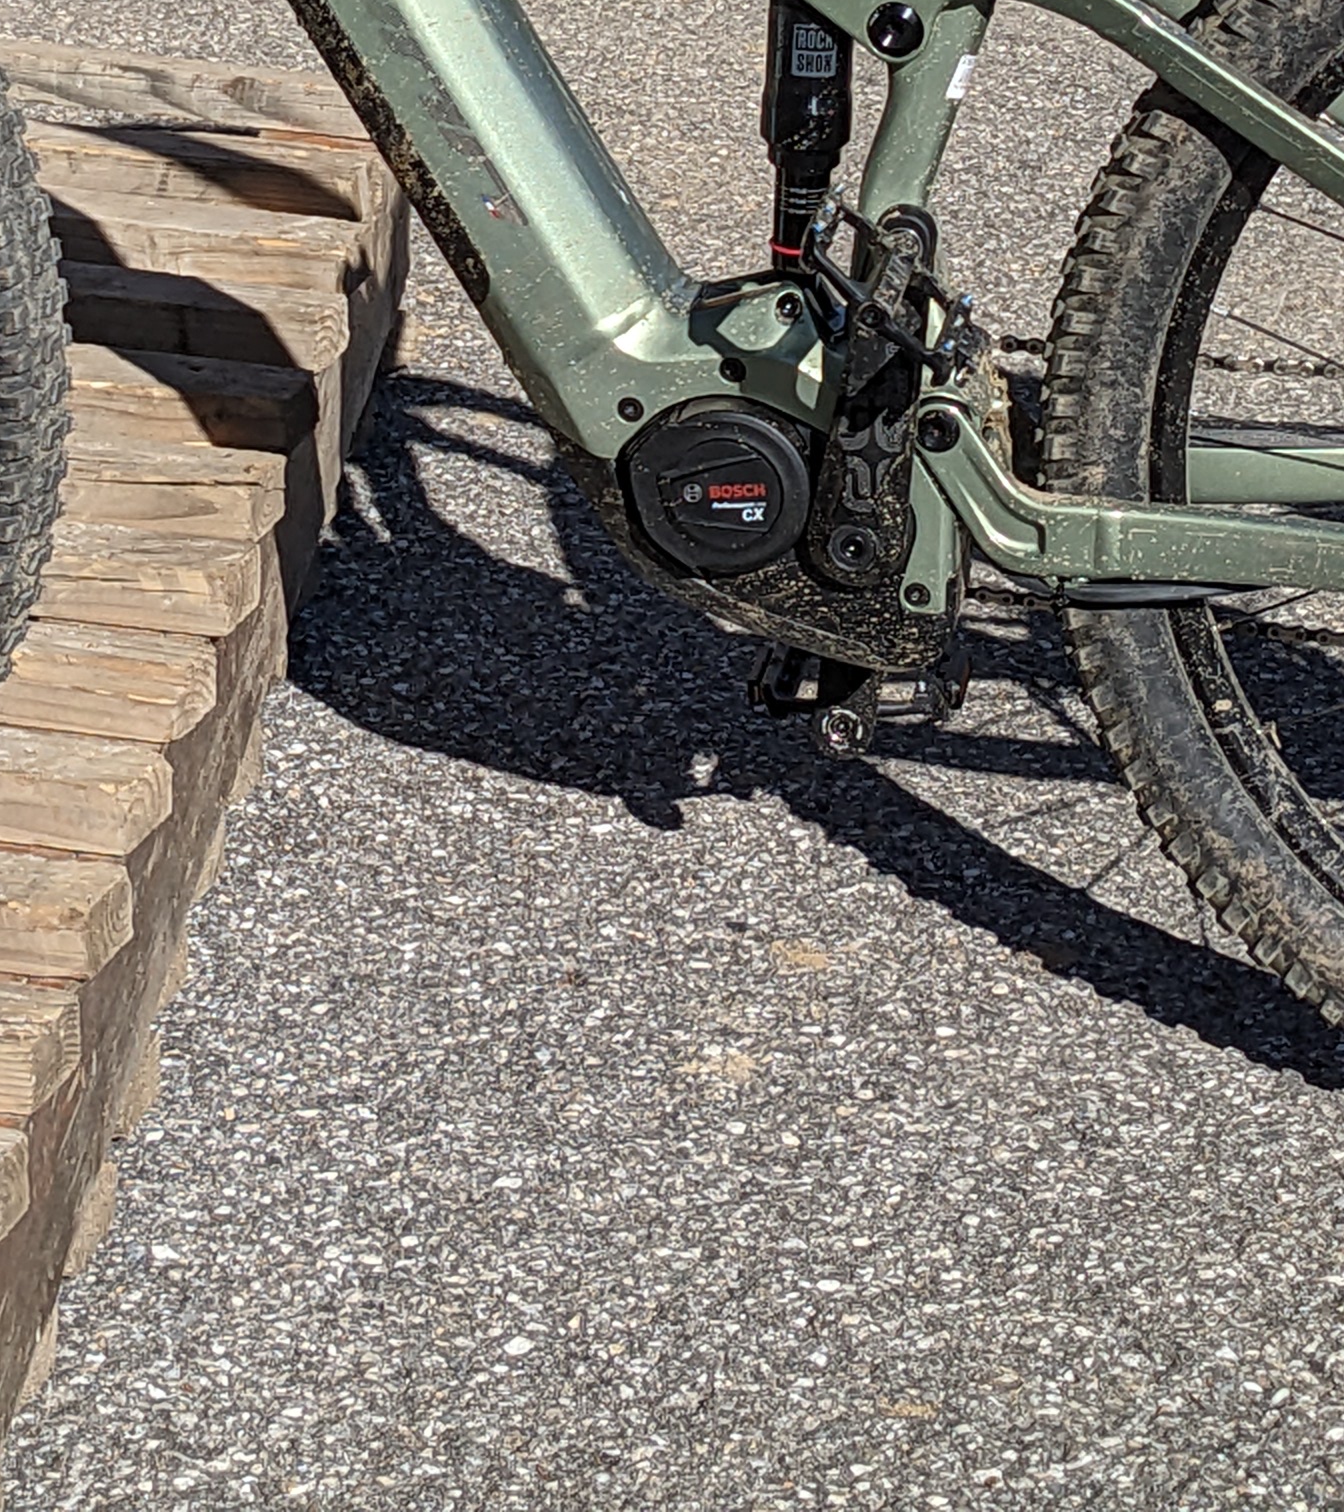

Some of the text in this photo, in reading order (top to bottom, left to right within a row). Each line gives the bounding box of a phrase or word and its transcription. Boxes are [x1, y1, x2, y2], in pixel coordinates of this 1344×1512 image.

[795, 28, 834, 49] ROCK
[796, 53, 834, 73] SHOX
[708, 483, 767, 499] BOSCH
[741, 507, 765, 522] CX
